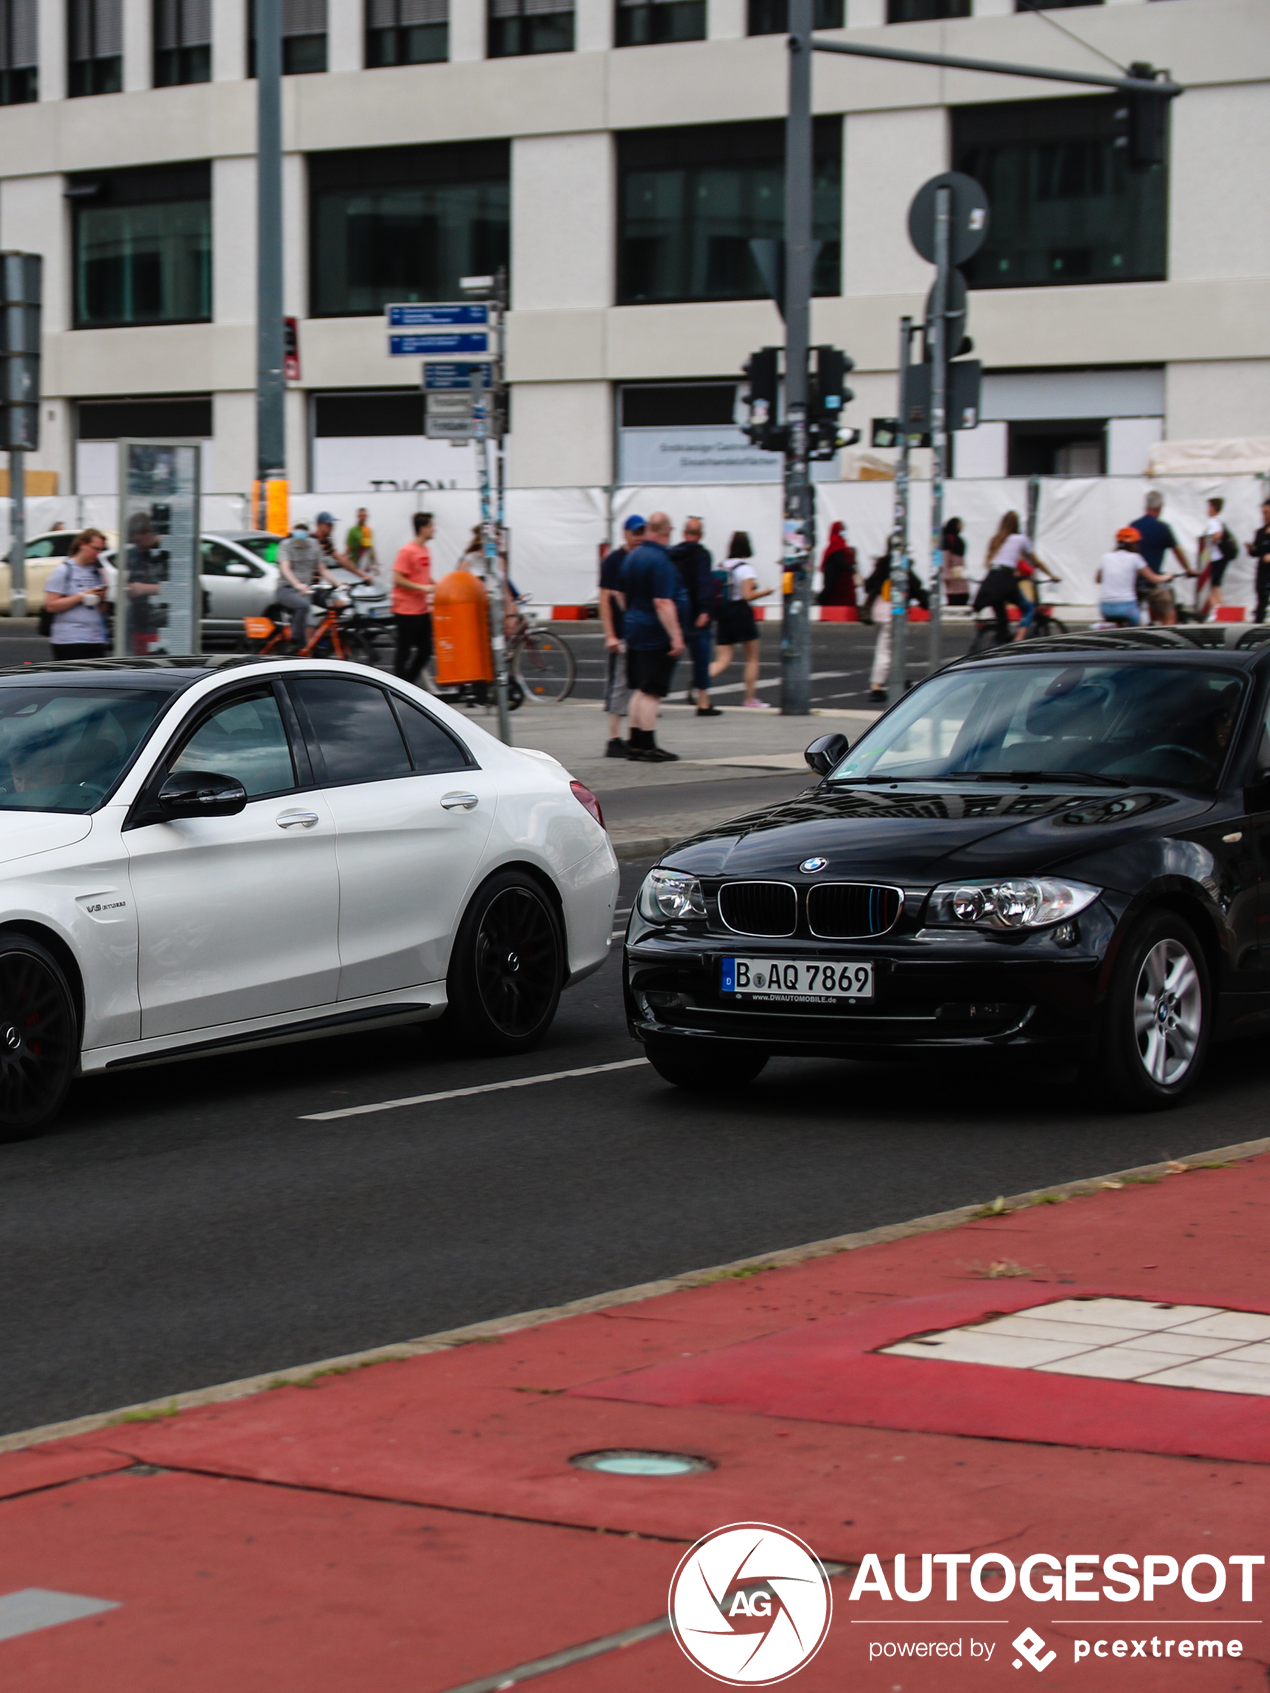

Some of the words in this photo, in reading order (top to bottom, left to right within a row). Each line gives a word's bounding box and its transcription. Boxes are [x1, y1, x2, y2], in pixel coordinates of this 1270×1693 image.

[736, 962, 751, 988] B
[767, 963, 799, 990] AQ
[805, 965, 870, 992] 7869
[752, 994, 837, 1004] www.DWAUTOMOBILE.de
